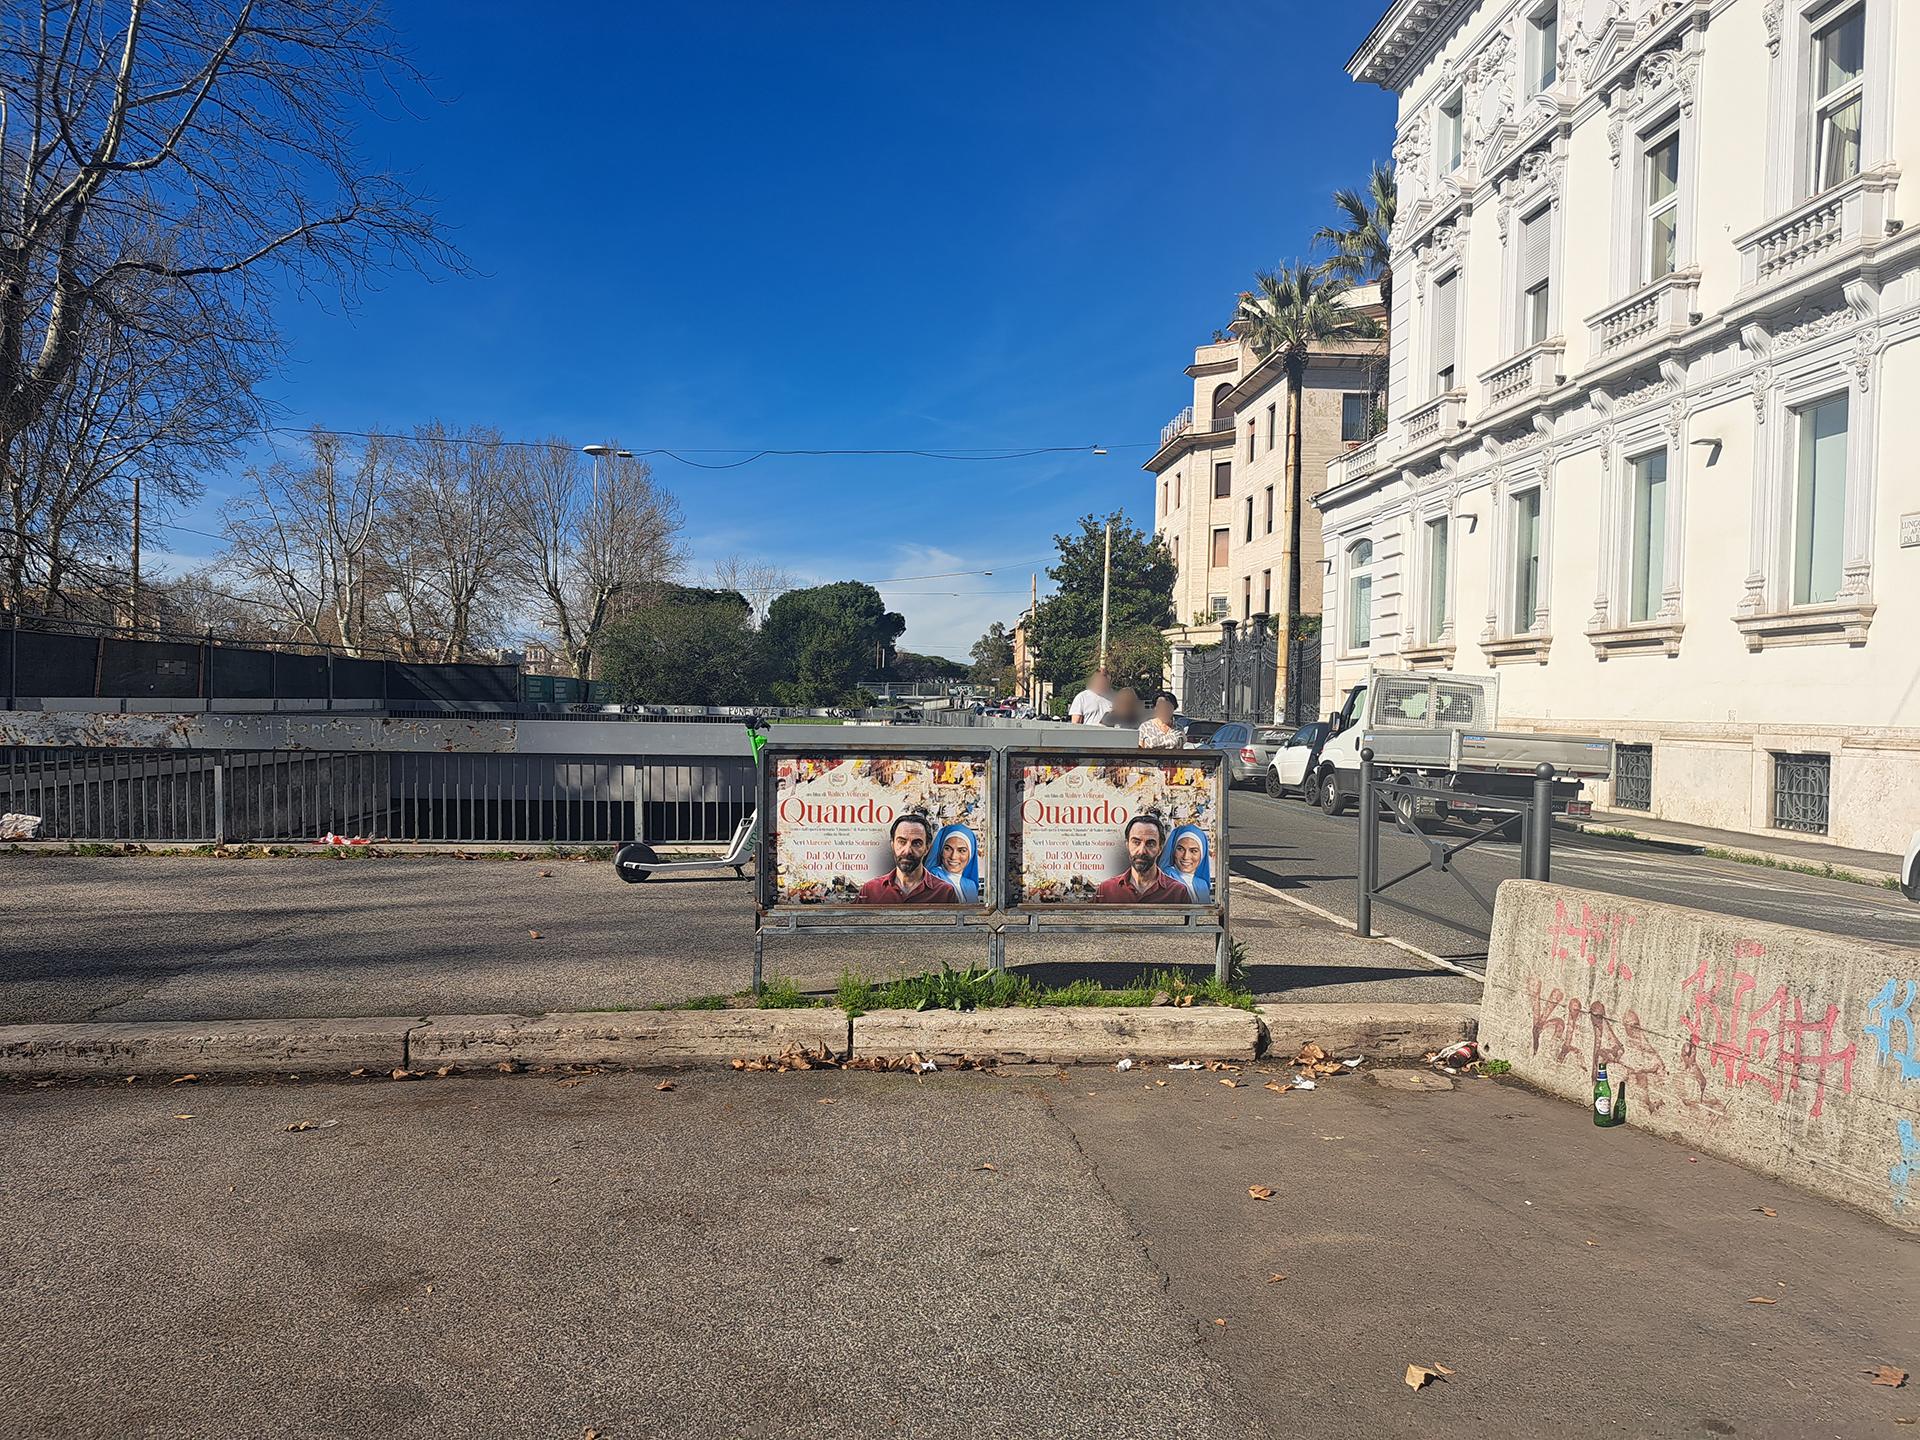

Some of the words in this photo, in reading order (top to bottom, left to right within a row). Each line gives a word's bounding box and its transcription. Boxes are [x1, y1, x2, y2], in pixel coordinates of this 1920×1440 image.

[780, 798, 894, 826] Quando
[1020, 799, 1128, 827] Quando
[806, 851, 820, 861] Dal
[822, 851, 835, 861] 30
[837, 851, 866, 861] Marzo
[1045, 851, 1059, 860] Dal
[1061, 851, 1073, 860] 30
[1074, 851, 1102, 860] Marzo
[802, 861, 823, 871] solo
[825, 861, 833, 871] al
[835, 861, 869, 871] Cinema
[1042, 861, 1062, 871] solo
[1063, 861, 1071, 870] al
[1072, 861, 1105, 870] Cinema
